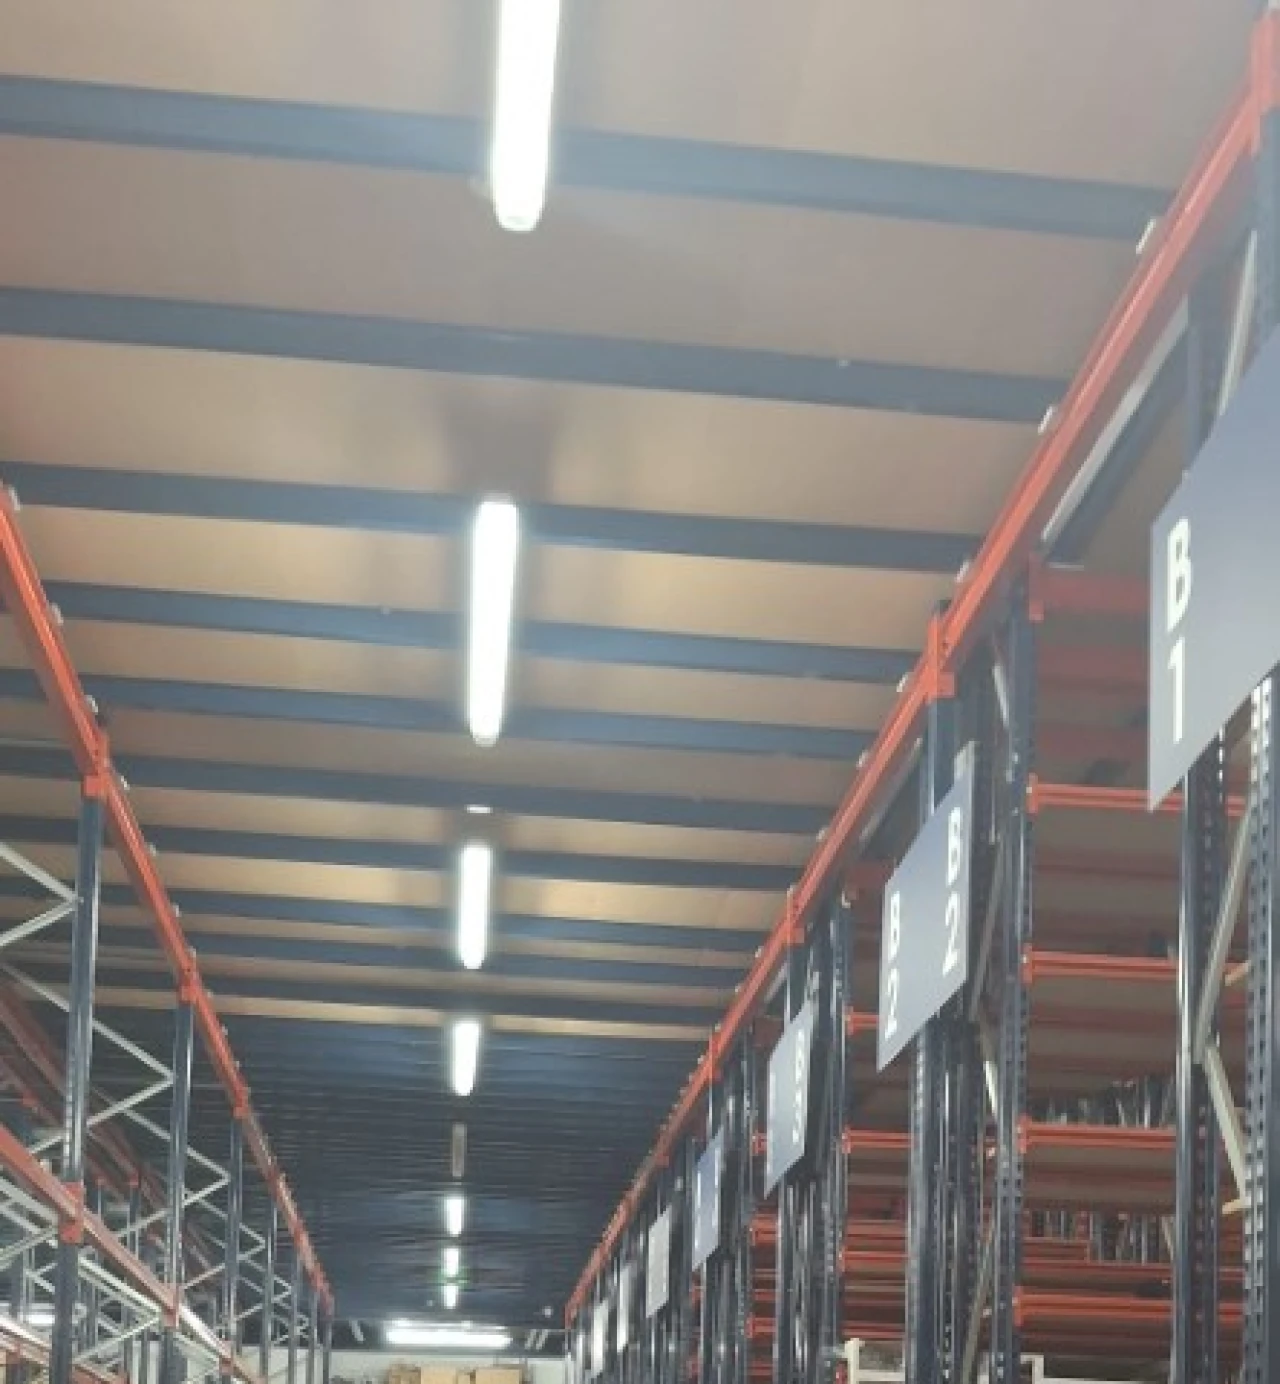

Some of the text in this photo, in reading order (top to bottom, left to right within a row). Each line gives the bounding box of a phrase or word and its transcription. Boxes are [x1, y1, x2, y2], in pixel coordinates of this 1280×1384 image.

[1167, 517, 1192, 631] B
[1168, 635, 1184, 743] 1
[947, 806, 961, 886] B
[888, 890, 900, 963] B
[943, 892, 960, 977] 2
[885, 967, 898, 1040] 2
